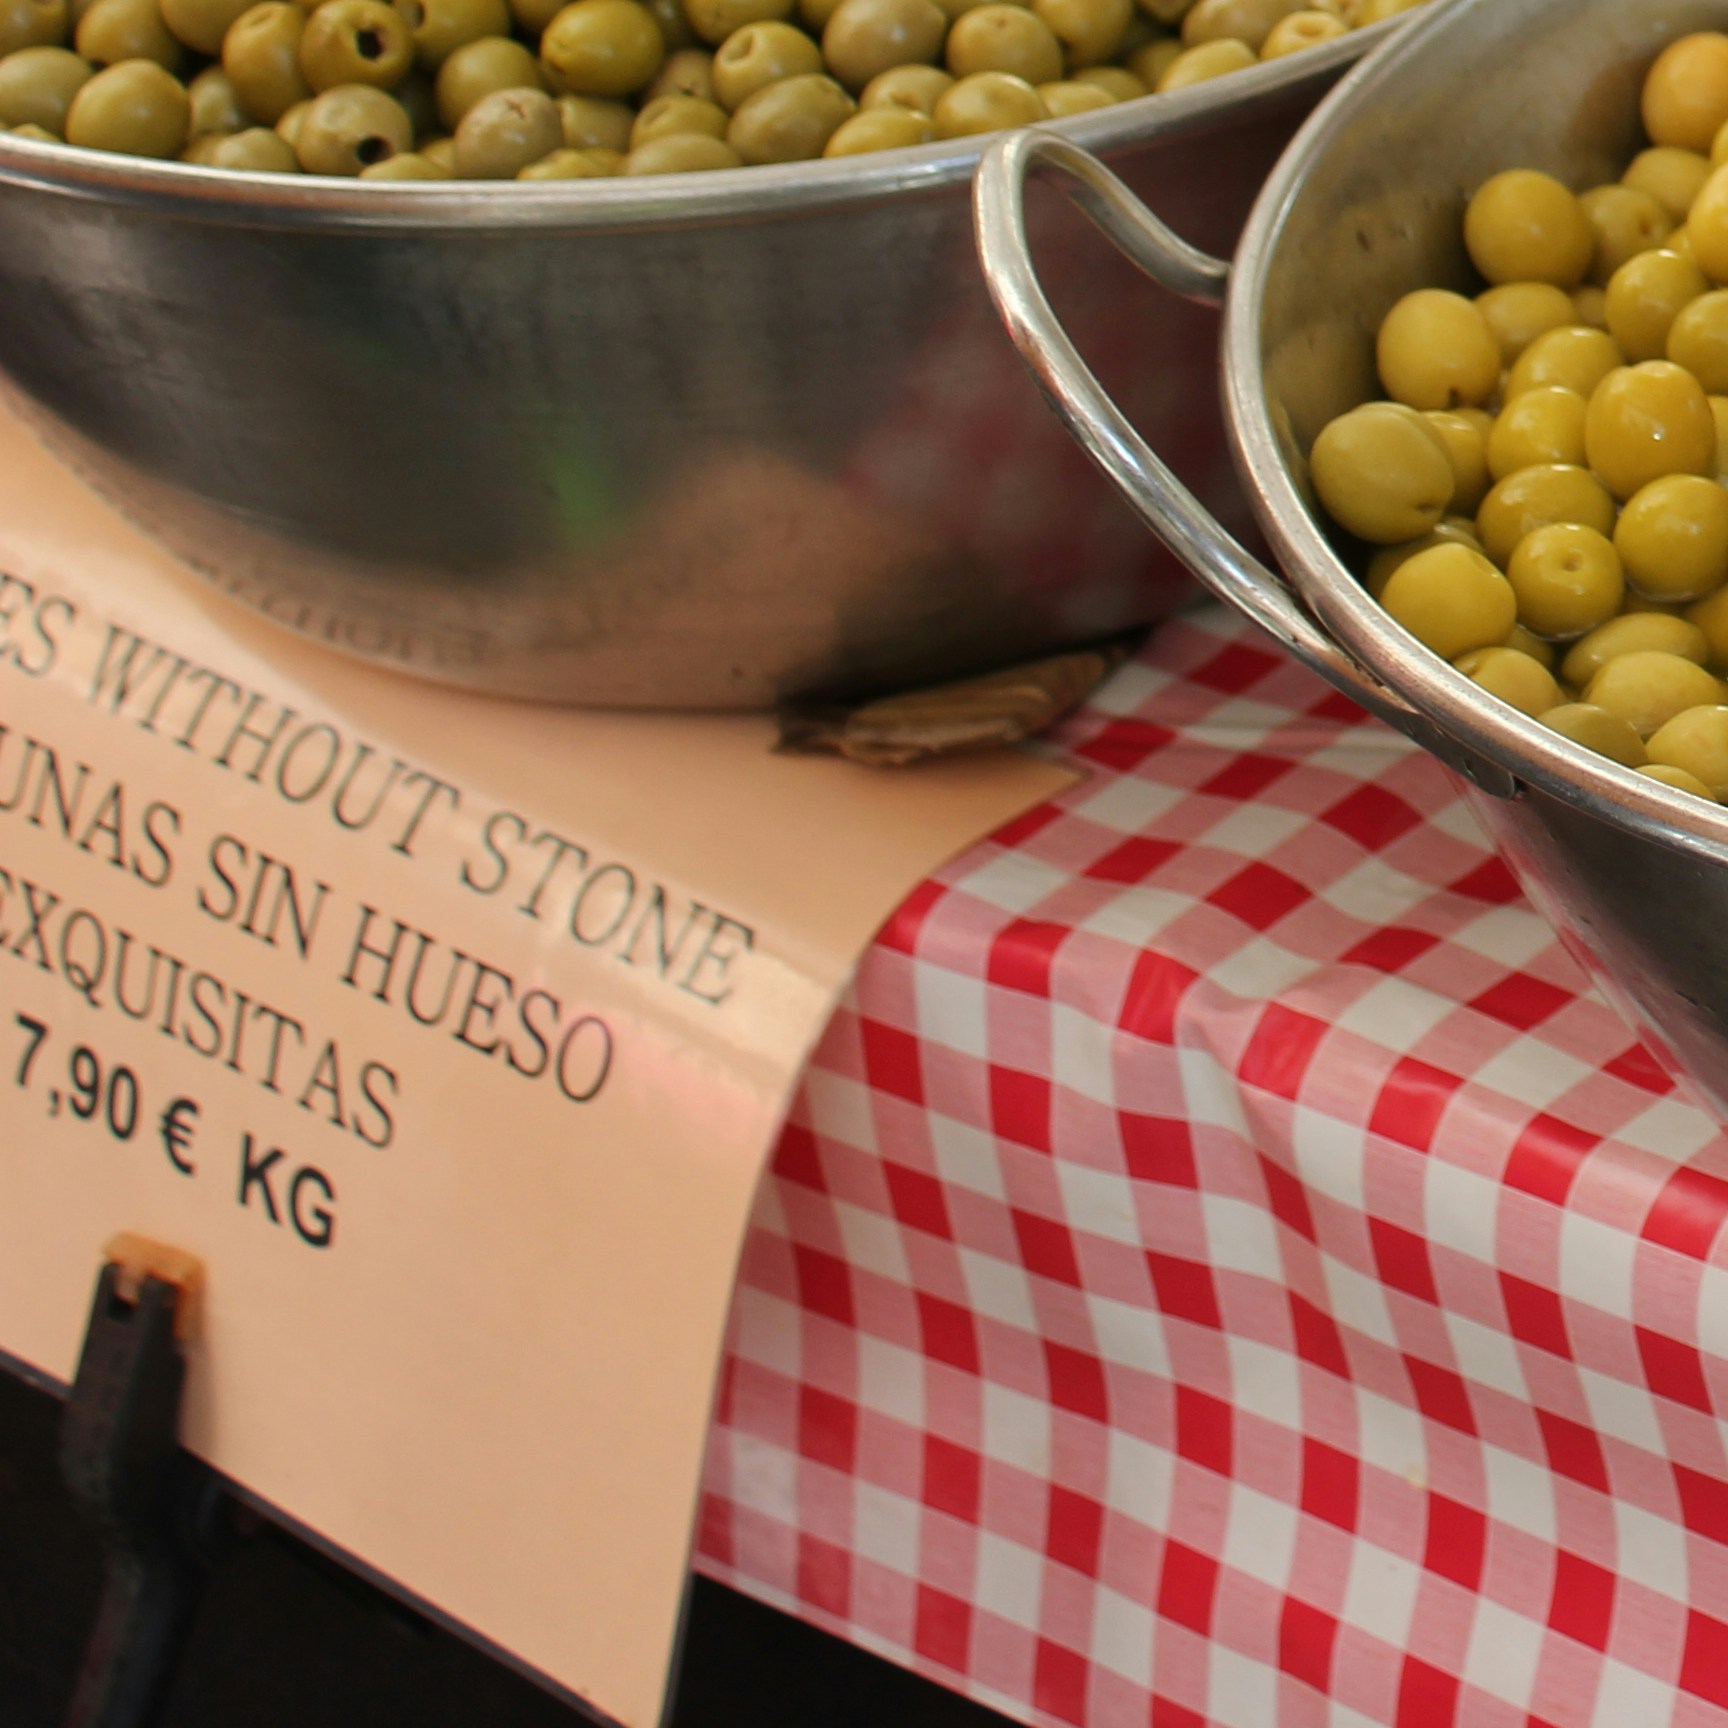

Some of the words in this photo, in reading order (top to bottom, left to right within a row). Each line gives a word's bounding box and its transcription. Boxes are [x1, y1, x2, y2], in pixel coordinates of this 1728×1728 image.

[88, 623, 460, 858] WITHOUT
[459, 810, 756, 1007] STONE
[0, 866, 399, 1149] XQUISITAS
[197, 834, 331, 960] SIN
[340, 904, 614, 1104] HUESO
[15, 1012, 141, 1142] 7,90
[158, 1095, 200, 1178] €
[237, 1129, 337, 1250] KG
